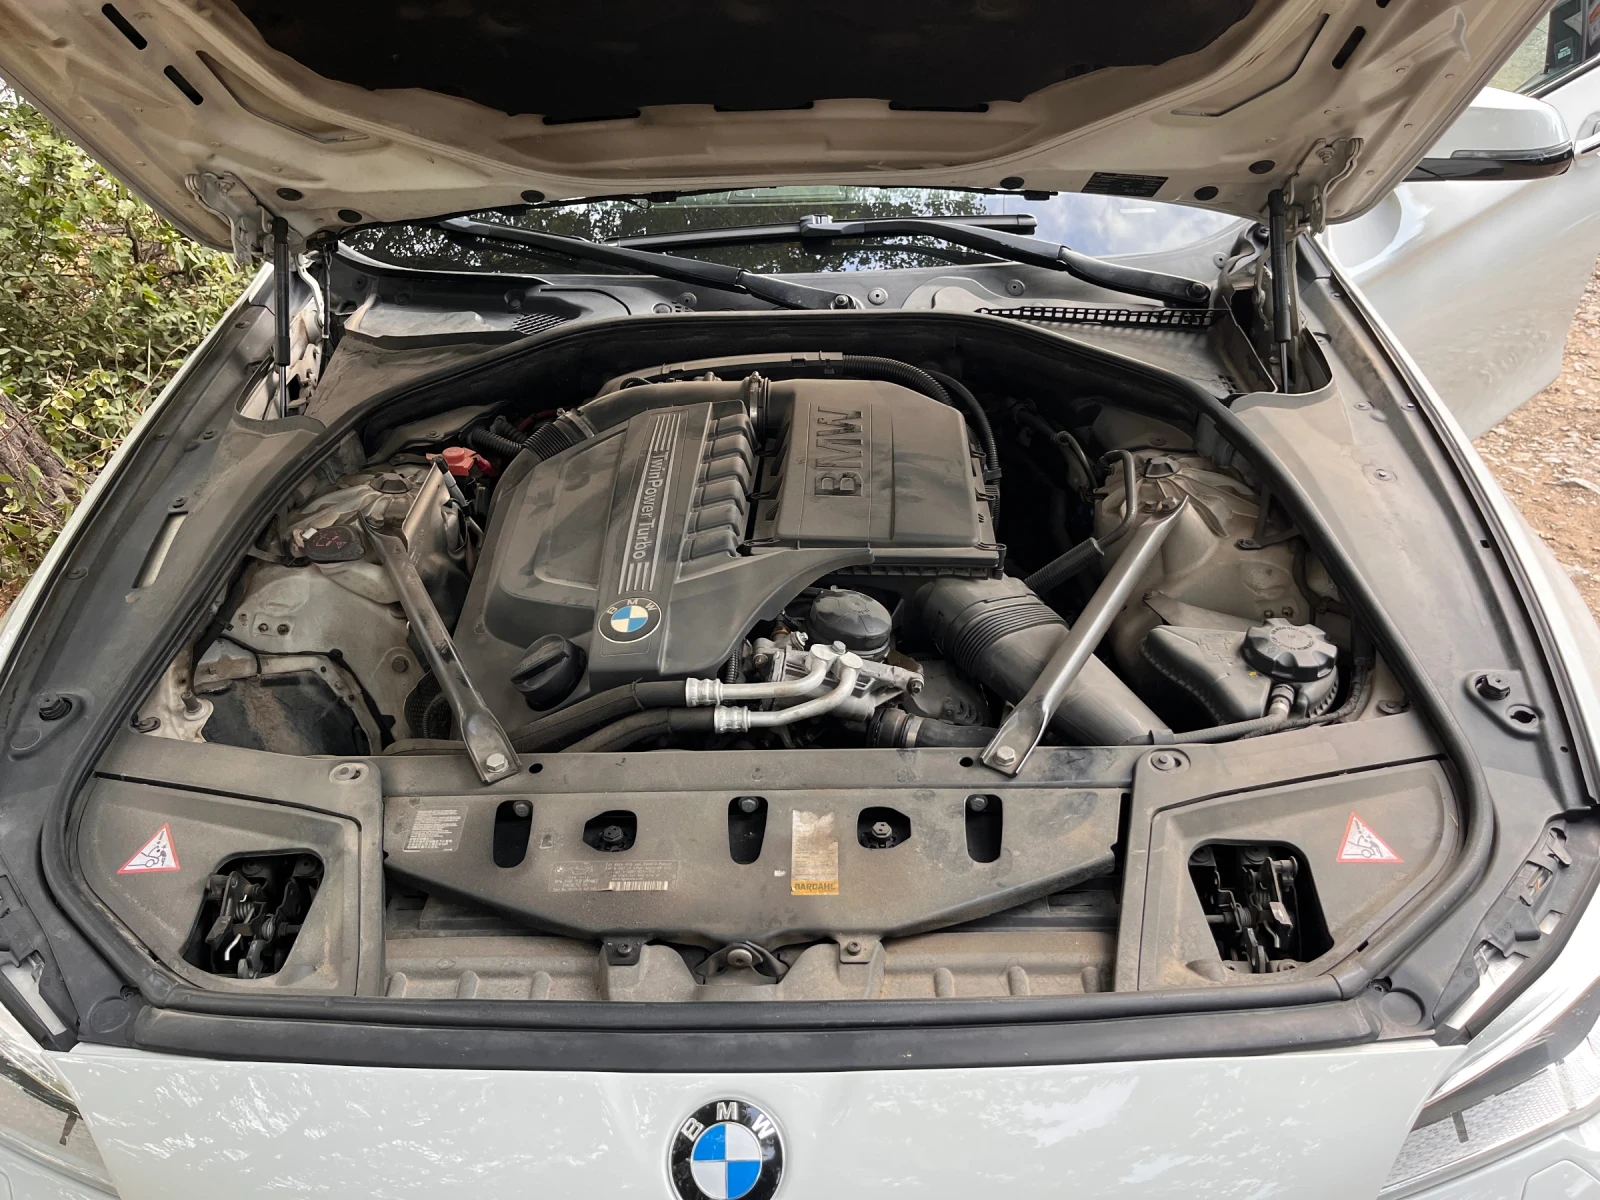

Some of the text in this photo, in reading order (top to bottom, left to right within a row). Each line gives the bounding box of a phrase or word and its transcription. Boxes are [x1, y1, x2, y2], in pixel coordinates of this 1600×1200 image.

[815, 406, 863, 497] BMW
[632, 450, 669, 560] TwinPower Turbo
[606, 599, 657, 615] BMW
[794, 883, 837, 891] BARDAHL
[681, 1101, 776, 1142] BMW
